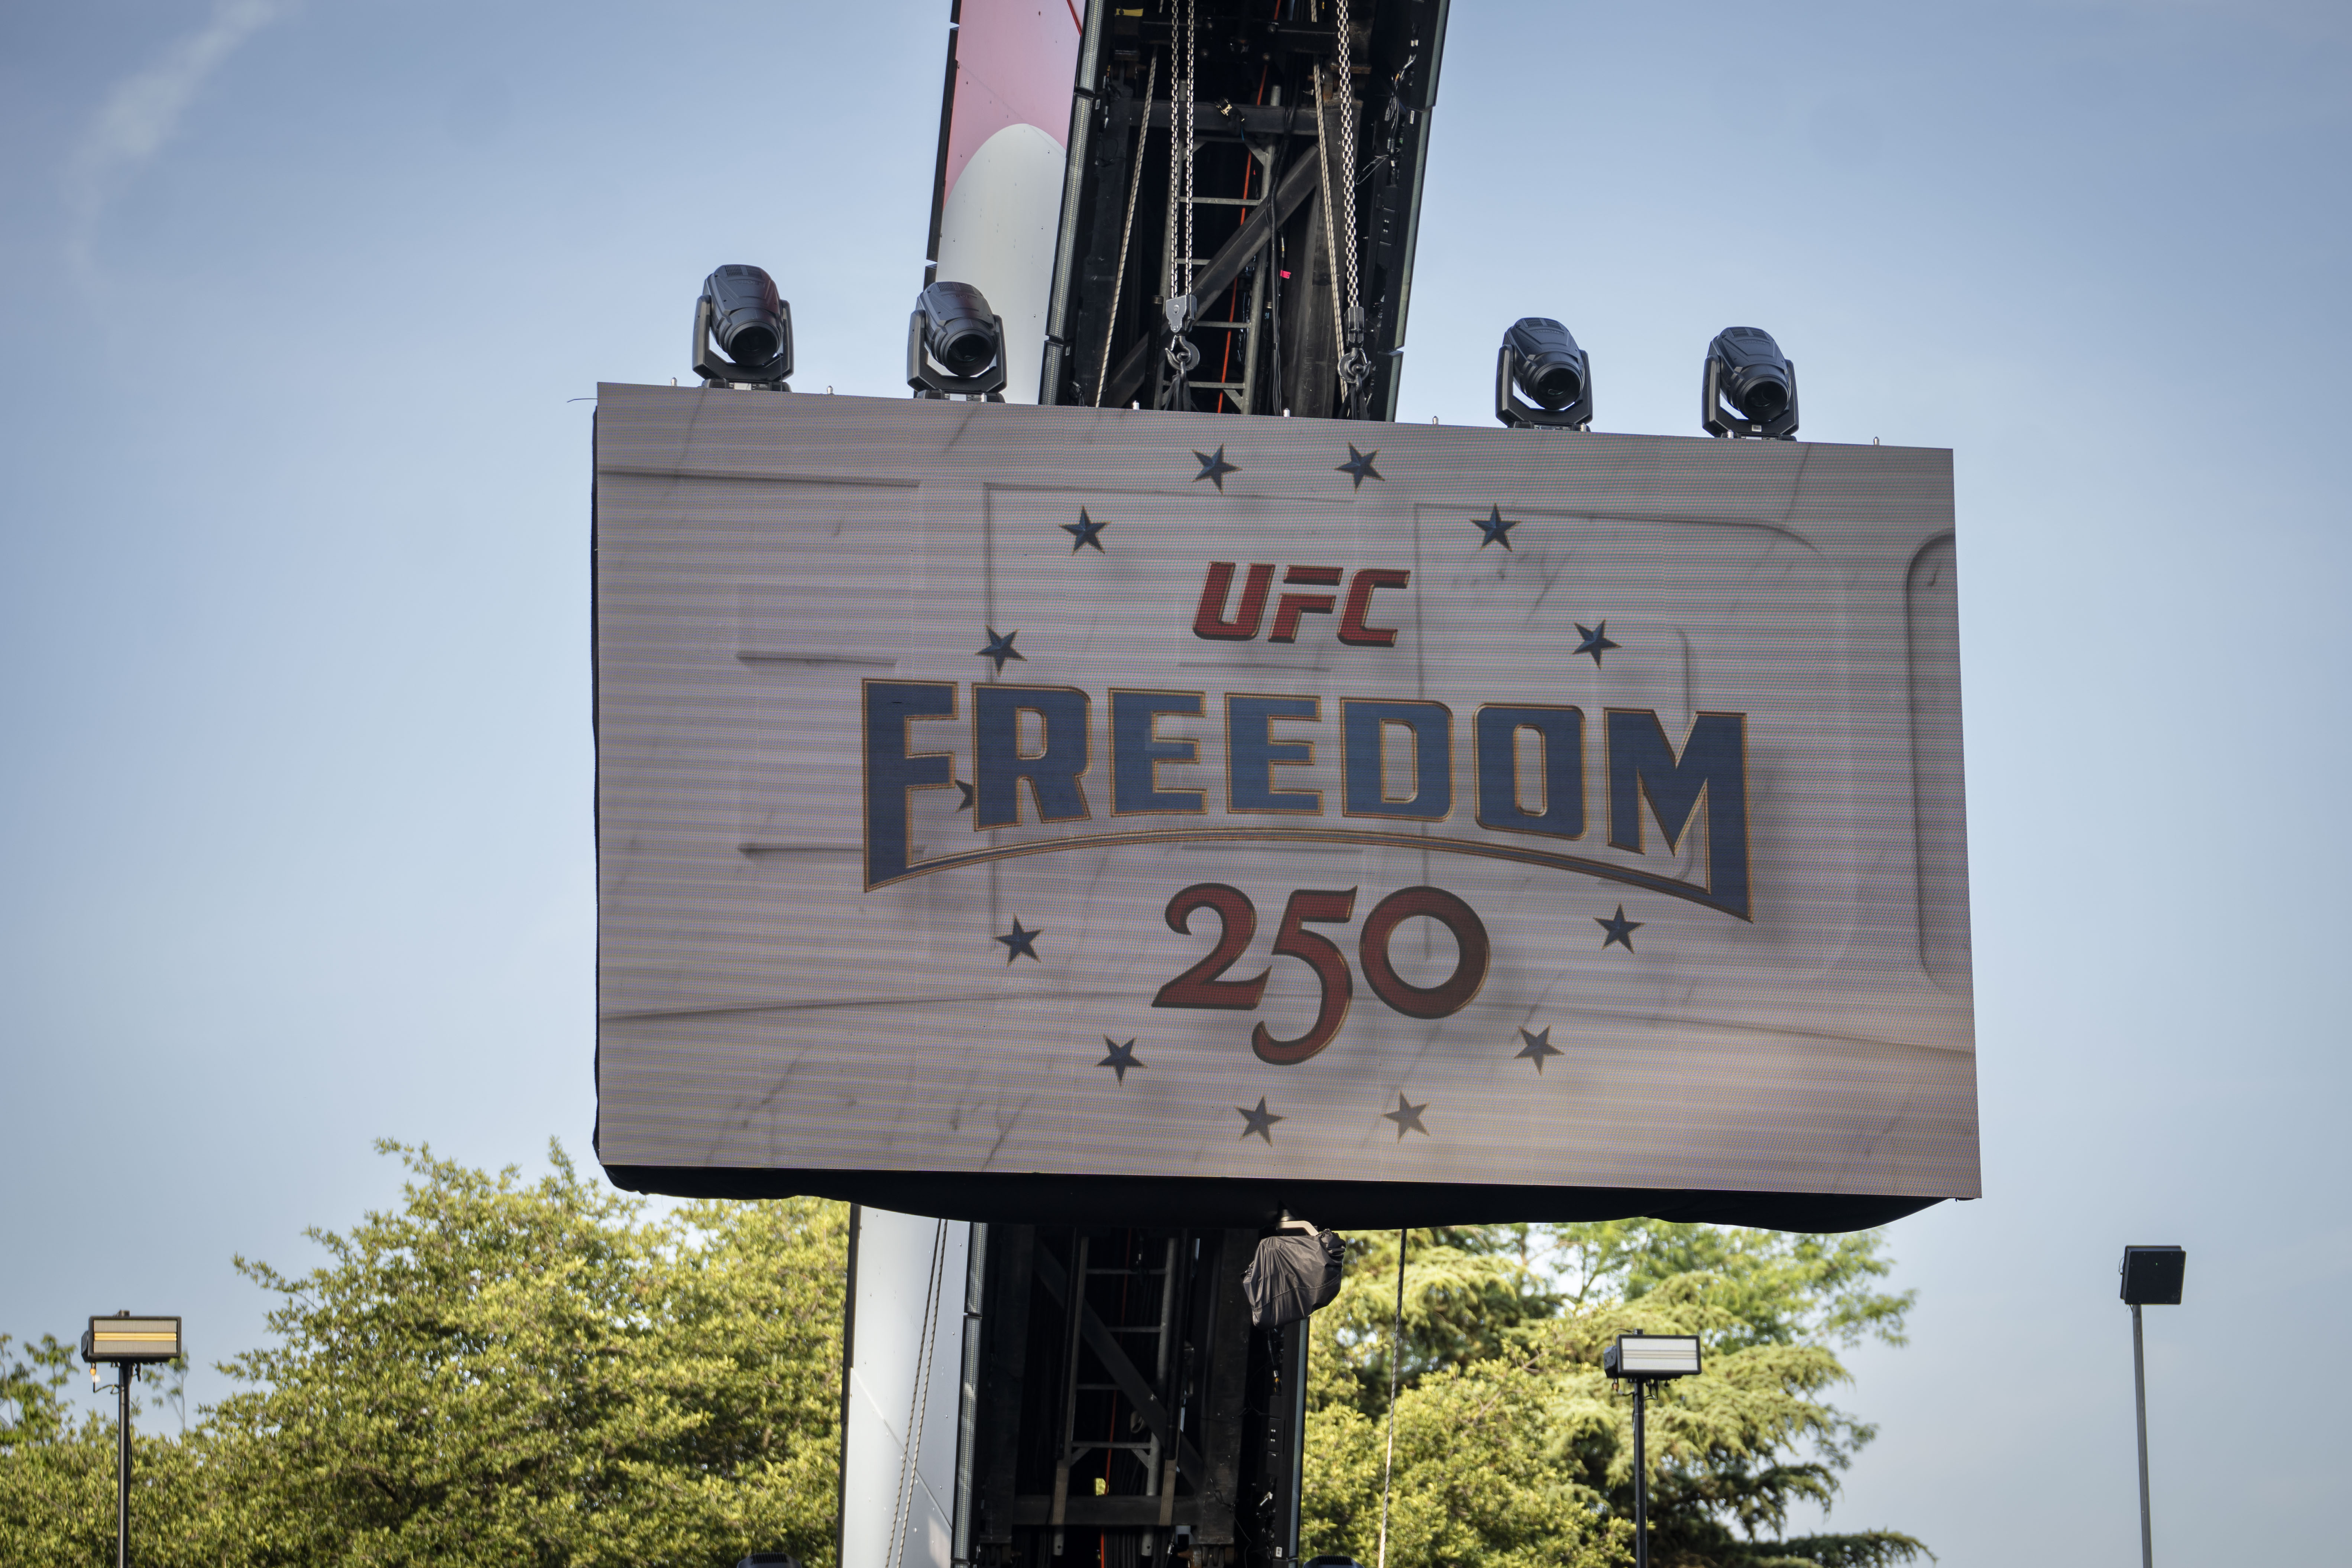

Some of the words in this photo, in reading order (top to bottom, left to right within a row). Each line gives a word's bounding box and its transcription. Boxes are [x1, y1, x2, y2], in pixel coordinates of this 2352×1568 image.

[1192, 561, 1411, 648] UFC
[862, 678, 1754, 923] FREEDOM
[1151, 882, 1490, 1066] 250
